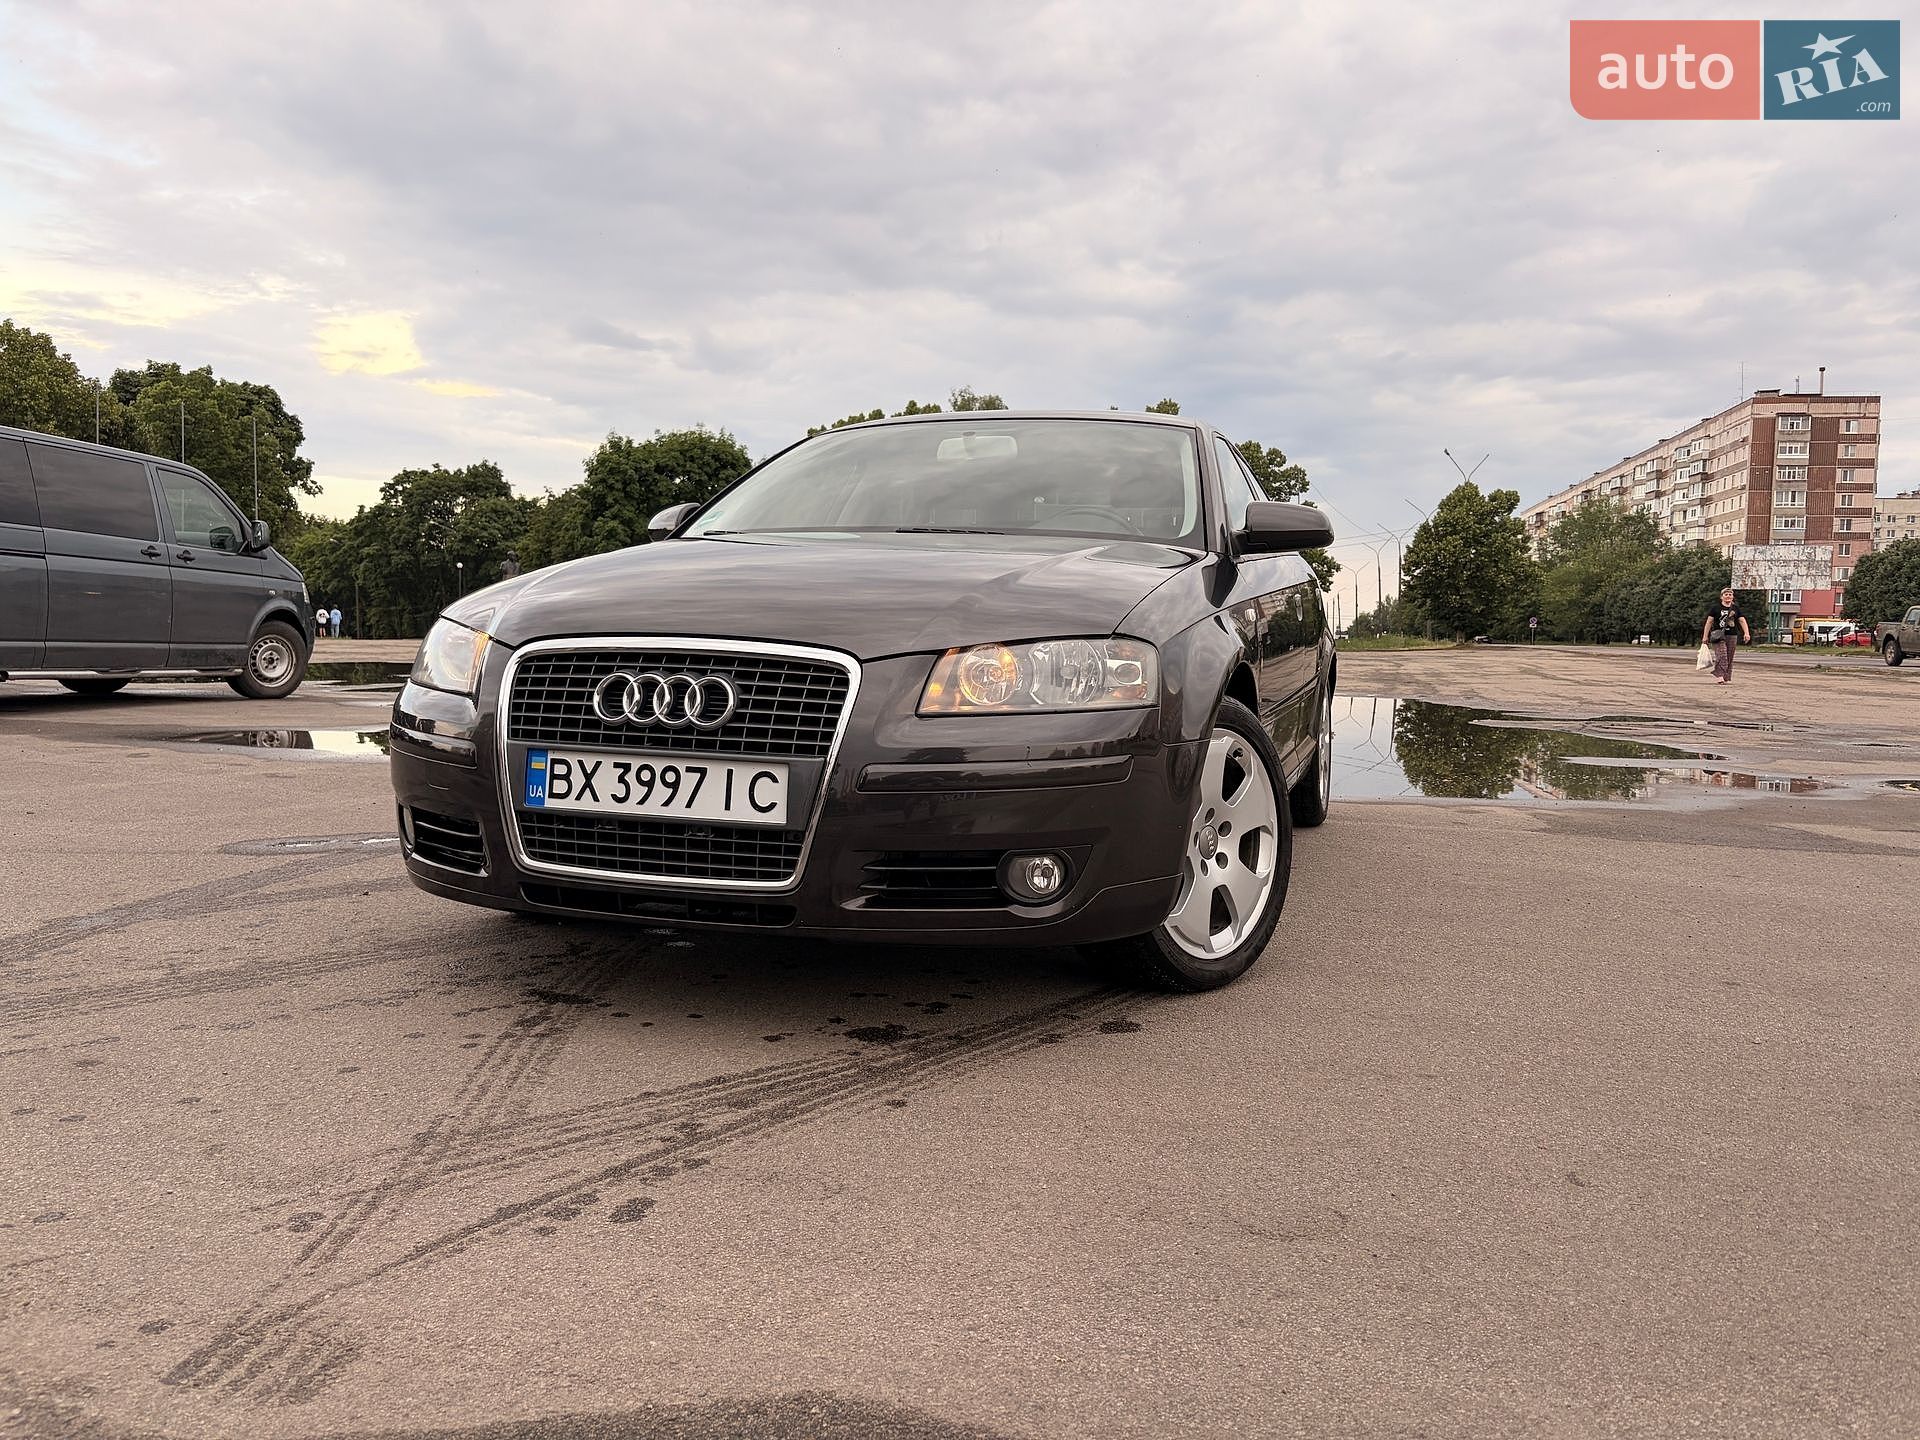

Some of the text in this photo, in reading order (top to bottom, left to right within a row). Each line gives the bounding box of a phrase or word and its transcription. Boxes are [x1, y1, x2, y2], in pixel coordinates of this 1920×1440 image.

[529, 785, 543, 797] UA
[548, 758, 779, 813] BX 3997 IC
